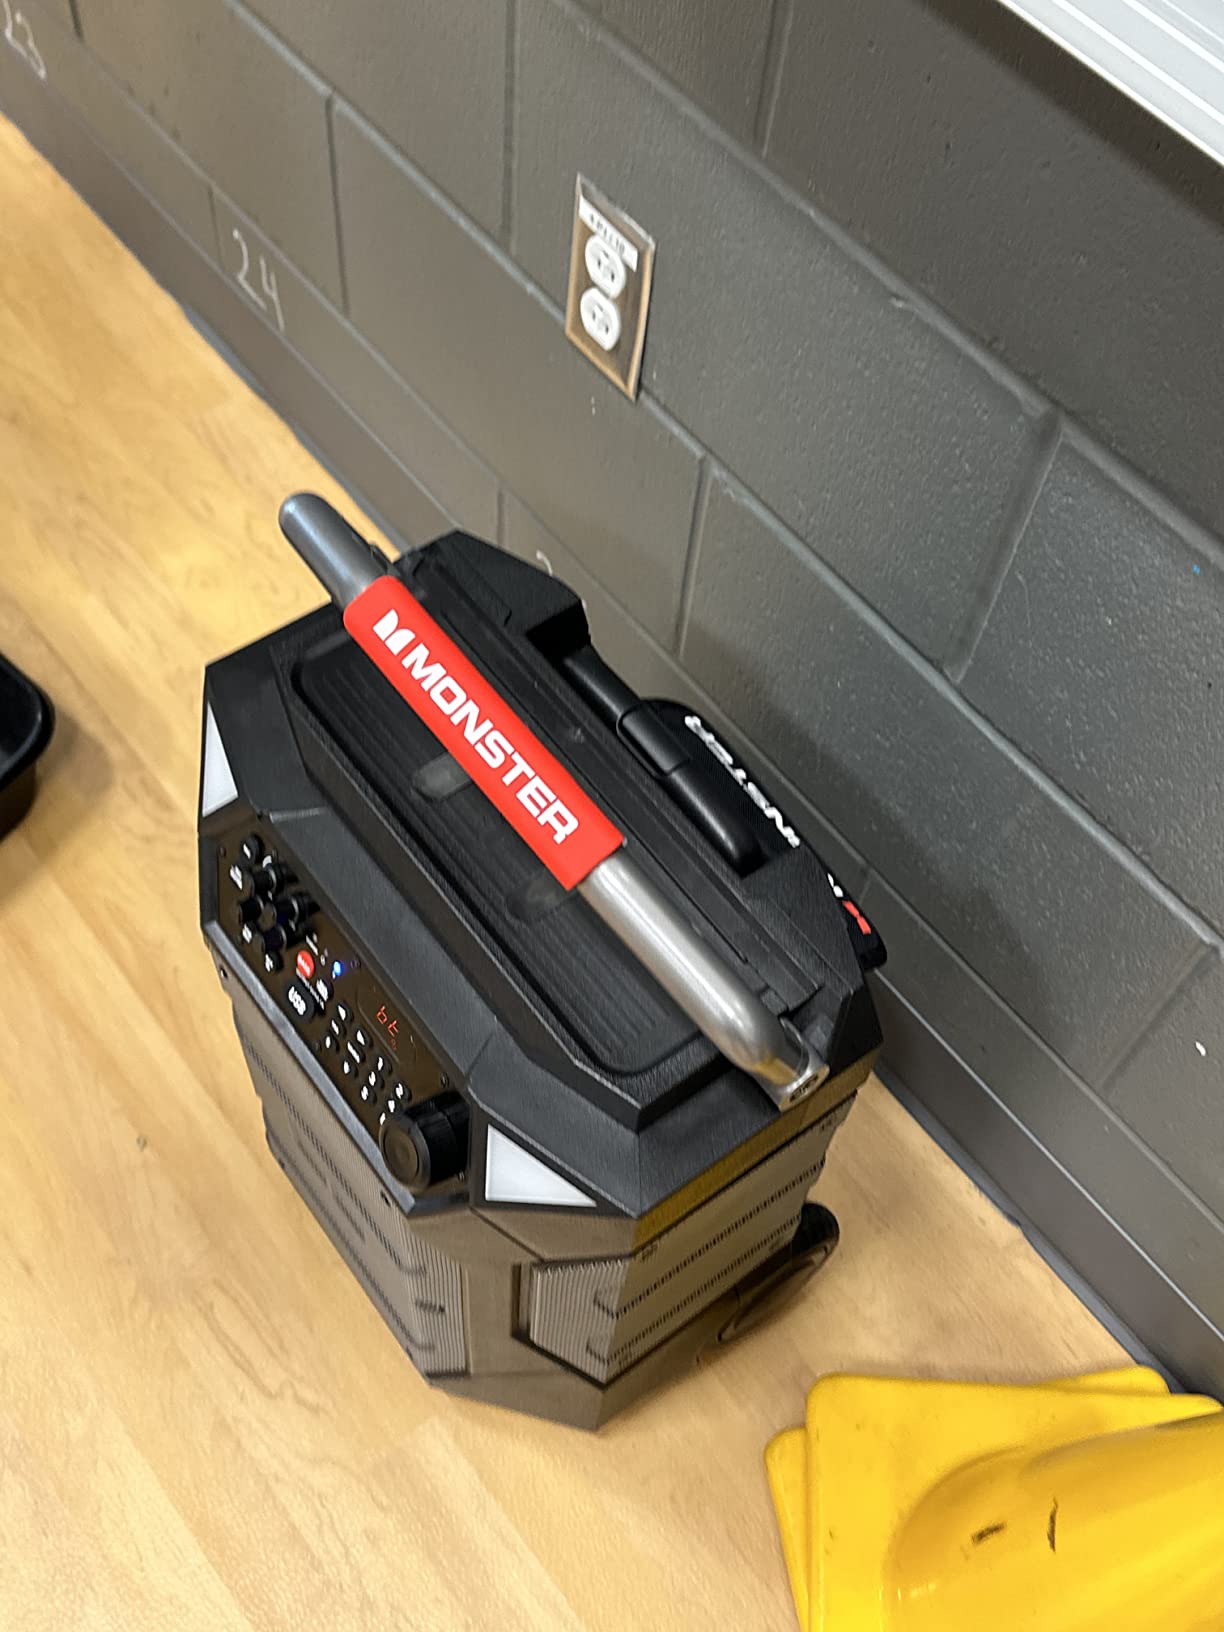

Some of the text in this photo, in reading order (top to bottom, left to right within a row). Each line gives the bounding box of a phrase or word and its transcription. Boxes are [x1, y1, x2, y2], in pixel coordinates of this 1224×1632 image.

[232, 228, 285, 333] 24
[401, 642, 579, 844] MONSTER
[376, 1005, 399, 1038] bt
